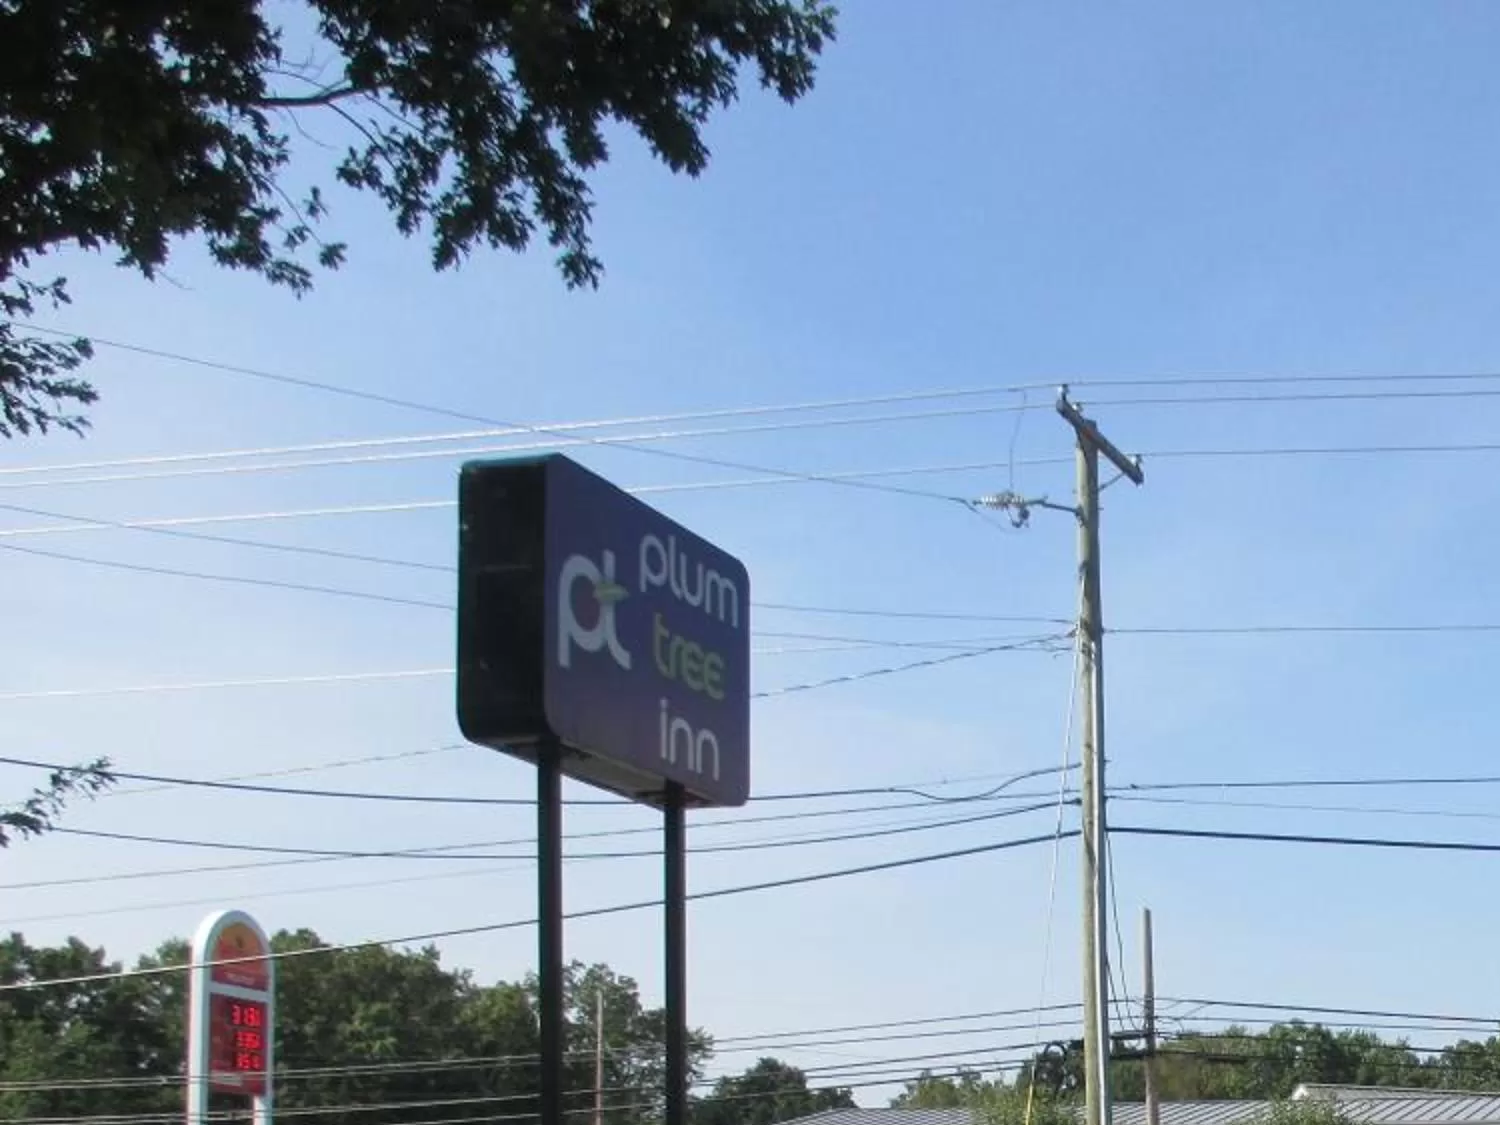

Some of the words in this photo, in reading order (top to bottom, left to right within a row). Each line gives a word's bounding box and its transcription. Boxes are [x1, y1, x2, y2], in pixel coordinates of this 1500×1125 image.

[639, 534, 739, 629] plum
[654, 611, 726, 701] tree
[659, 696, 720, 782] inn
